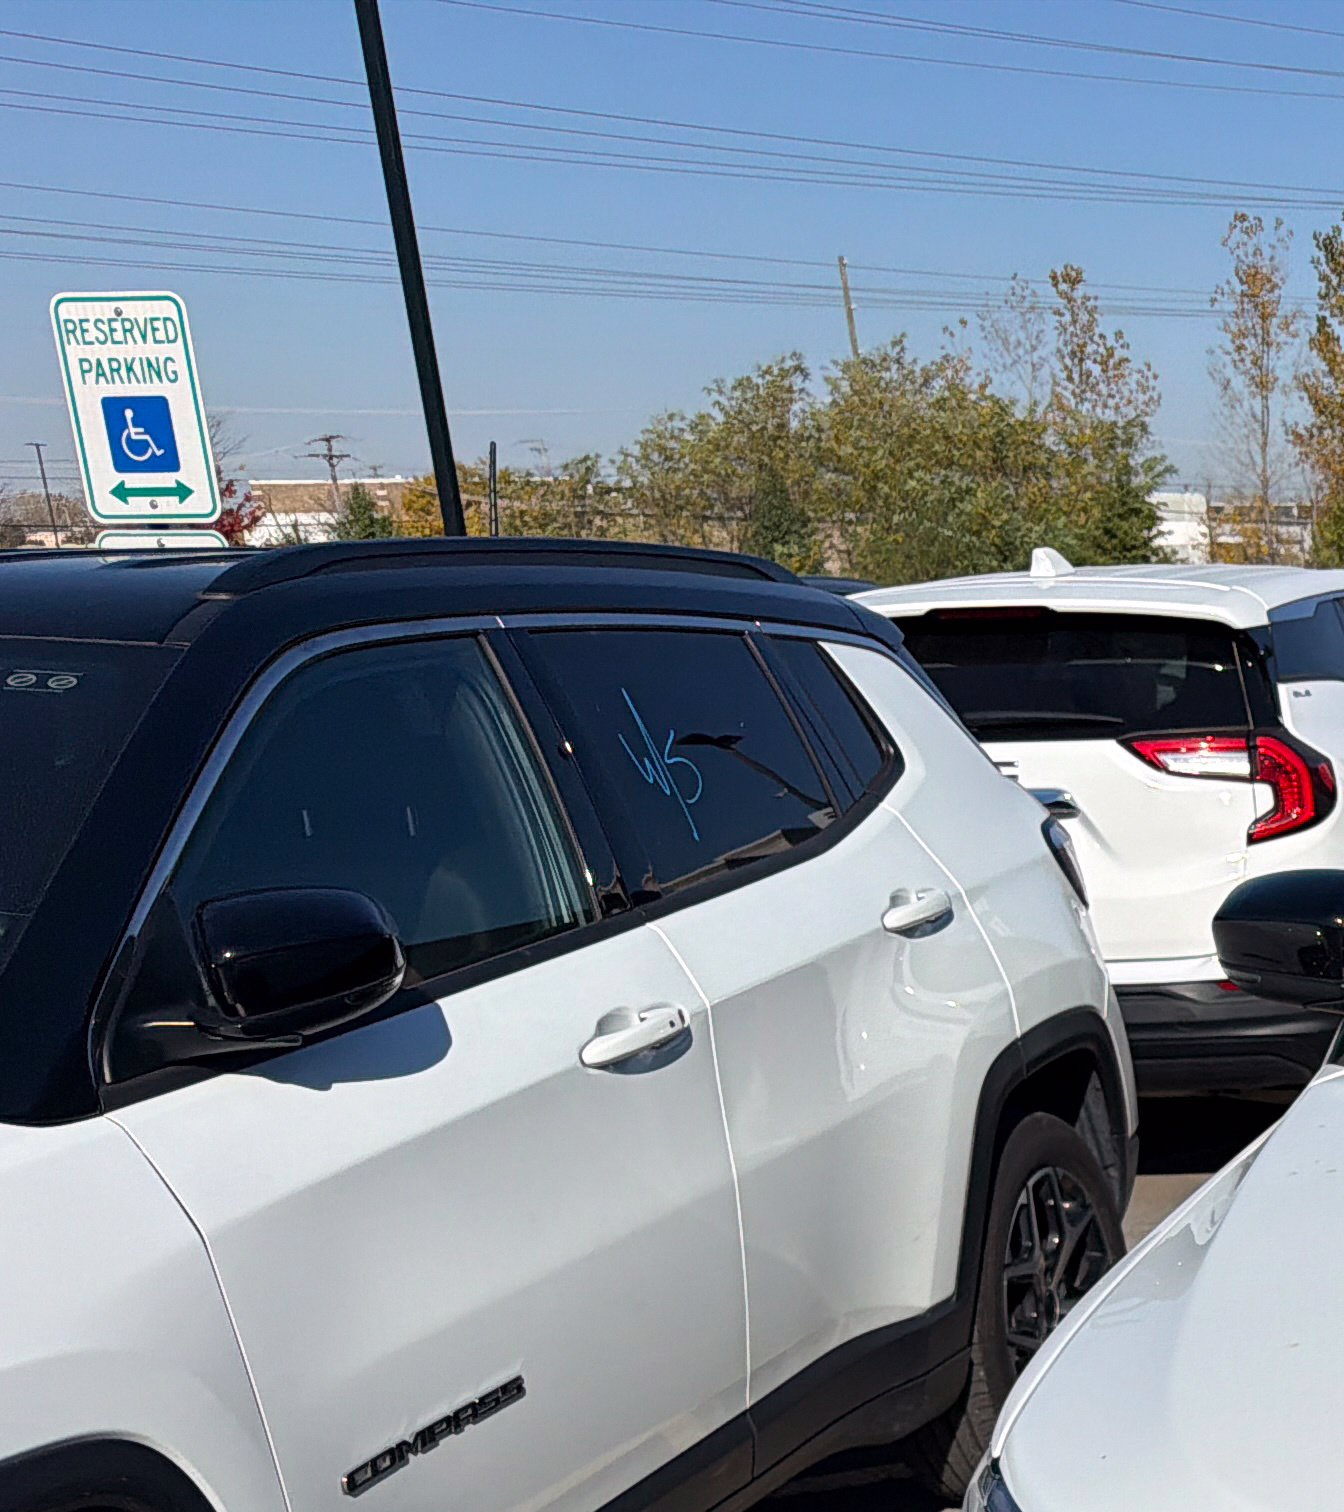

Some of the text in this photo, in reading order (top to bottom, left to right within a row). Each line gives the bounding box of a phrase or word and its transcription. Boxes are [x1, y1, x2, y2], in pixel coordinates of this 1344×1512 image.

[62, 316, 179, 346] RESERVED
[77, 356, 179, 385] PARKING
[341, 1374, 527, 1499] COMPASS
